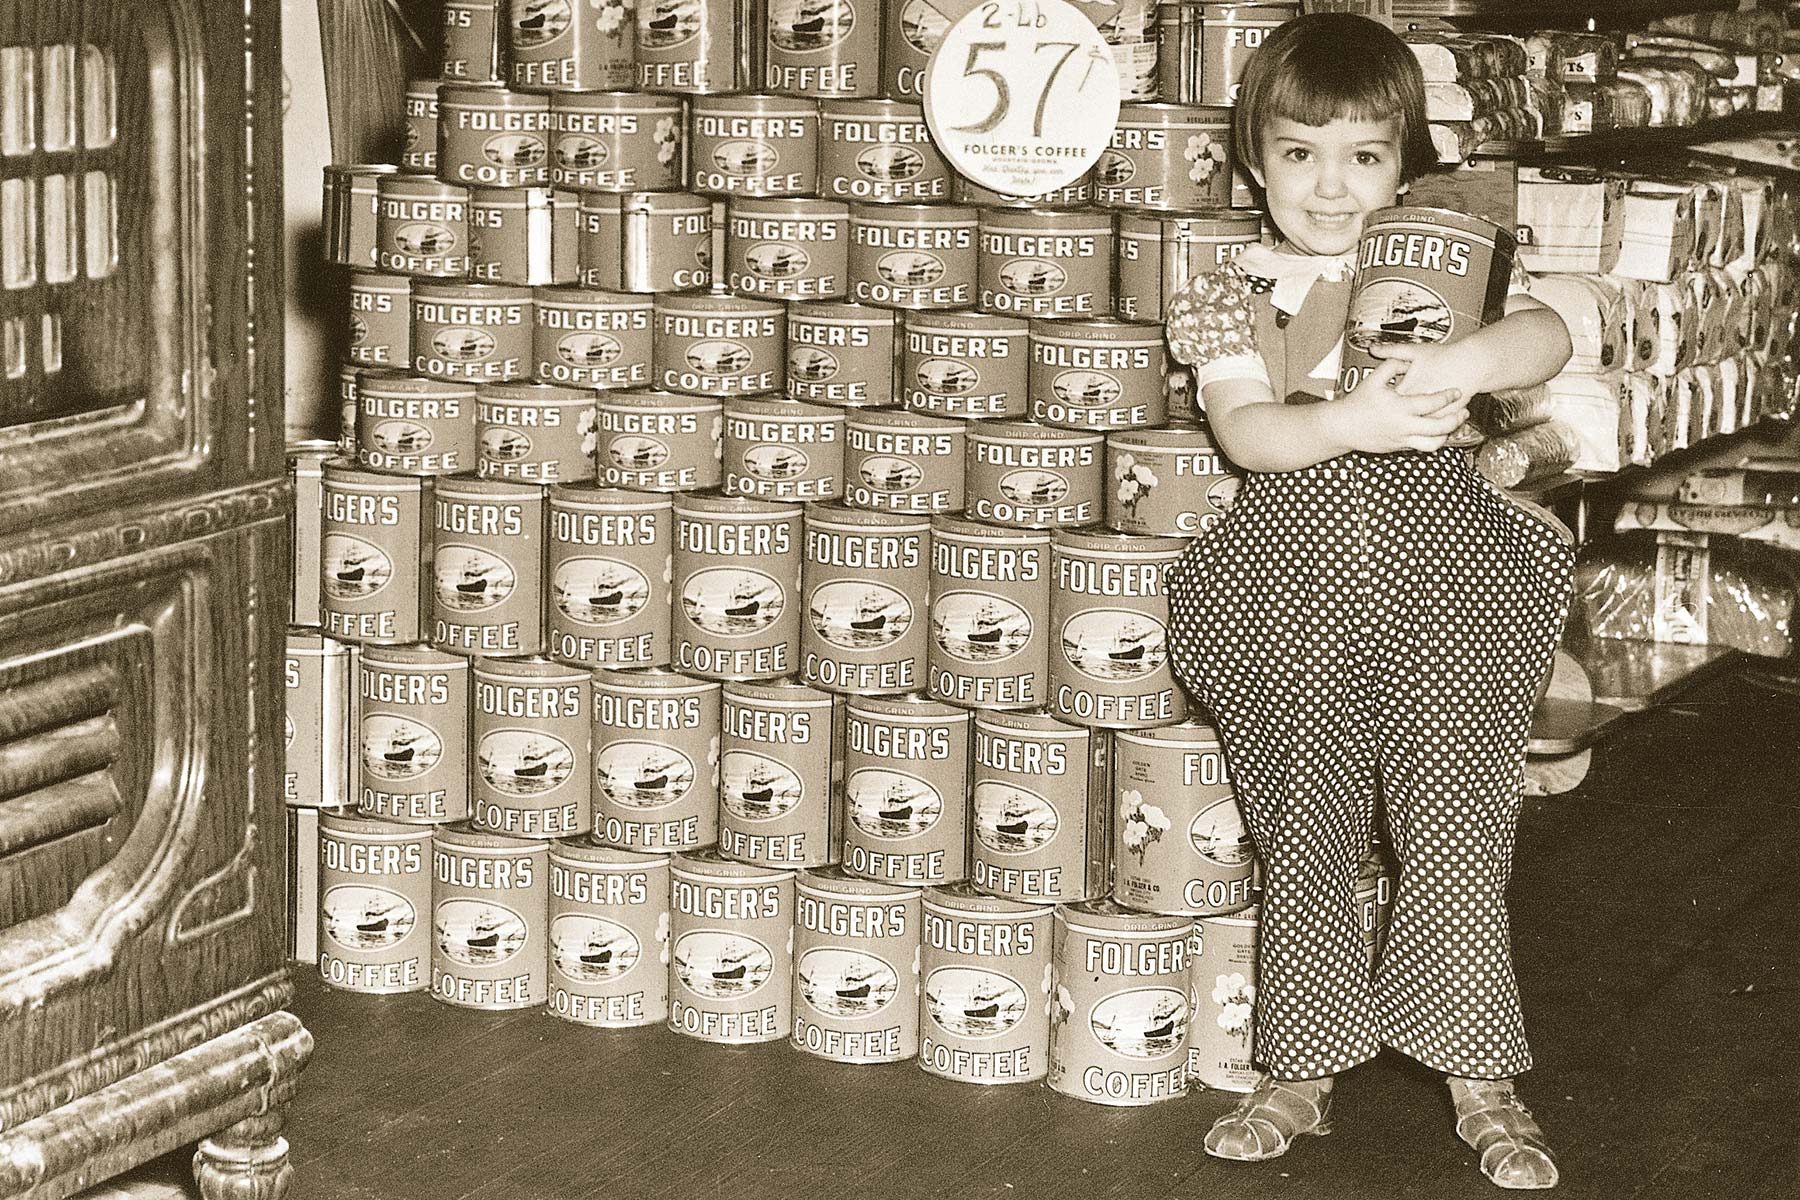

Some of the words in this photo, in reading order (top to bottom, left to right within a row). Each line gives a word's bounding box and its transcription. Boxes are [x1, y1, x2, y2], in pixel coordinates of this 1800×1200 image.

[697, 118, 804, 138] FOLGER'S
[965, 143, 1028, 157] FOLGER'S
[1036, 146, 1087, 158] COFFEE
[696, 172, 803, 191] COFFEE
[833, 176, 945, 197] COFFEE
[731, 218, 837, 241] FOLGER'S
[857, 228, 970, 249] FOLGER'S
[730, 273, 835, 294] COFFEE
[857, 282, 968, 303] COFFEE
[982, 292, 1093, 313] COFFEE
[416, 305, 521, 325] FOLGER'S
[539, 310, 646, 330] FOLGER'S
[665, 317, 775, 337] FOLGER'S
[1085, 331, 1116, 339] GRIND
[416, 356, 520, 377] COFFEE
[1034, 343, 1149, 370] FOLGER'S
[539, 362, 646, 381] COFFEE
[664, 370, 774, 390] COFFEE
[1033, 400, 1148, 425] COFFEE
[727, 420, 835, 443] FOLGER'S
[1033, 431, 1064, 439] GRIND
[977, 443, 1093, 468] FOLGER'S
[727, 473, 834, 497] COFFEE
[976, 500, 1091, 524] COFFEE
[680, 520, 790, 556] FOLGER'S
[807, 530, 919, 569] FOLGER'S
[1114, 543, 1146, 552] GRIND
[679, 641, 788, 674] COFFEE
[806, 652, 915, 688] COFFEE
[1058, 683, 1173, 721] COFFEE
[475, 799, 578, 833] COFFEE
[594, 811, 699, 847] COFFEE
[845, 839, 946, 880] COFFEE
[673, 878, 780, 920] FOLGER'S
[924, 913, 1034, 956] FOLGER'S
[1151, 920, 1178, 930] GRIND
[320, 951, 419, 988] COFFEE
[434, 966, 530, 1005] COFFEE
[672, 1000, 777, 1038] COFFEE
[795, 1016, 901, 1057] COFFEE
[922, 1037, 1031, 1079] COFFEE
[1083, 1065, 1188, 1099] COFFEE
